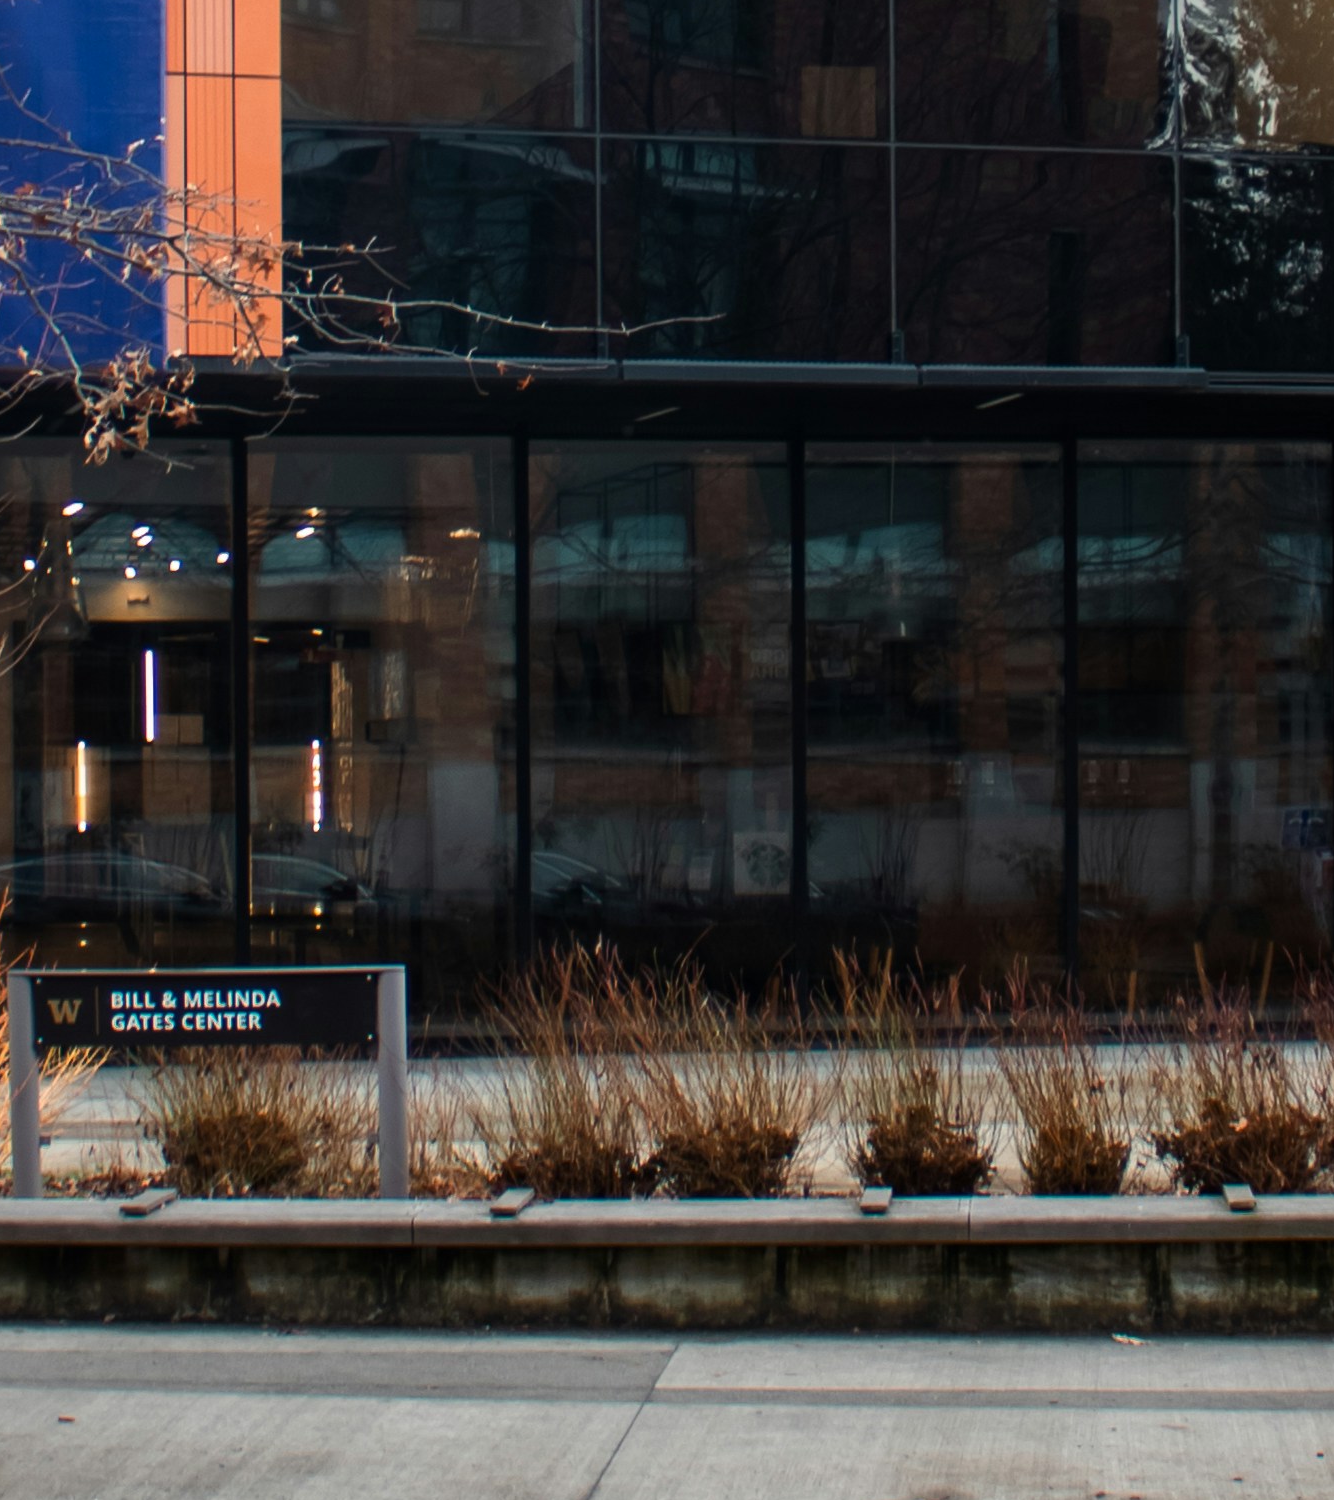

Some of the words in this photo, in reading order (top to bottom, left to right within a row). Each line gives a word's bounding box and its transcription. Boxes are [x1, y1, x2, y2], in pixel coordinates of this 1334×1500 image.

[110, 991, 156, 1010] BILL
[161, 991, 177, 1009] &
[183, 989, 281, 1009] MELINDA
[47, 999, 83, 1025] W
[111, 1012, 175, 1032] GATES
[181, 1012, 262, 1031] CENTER
